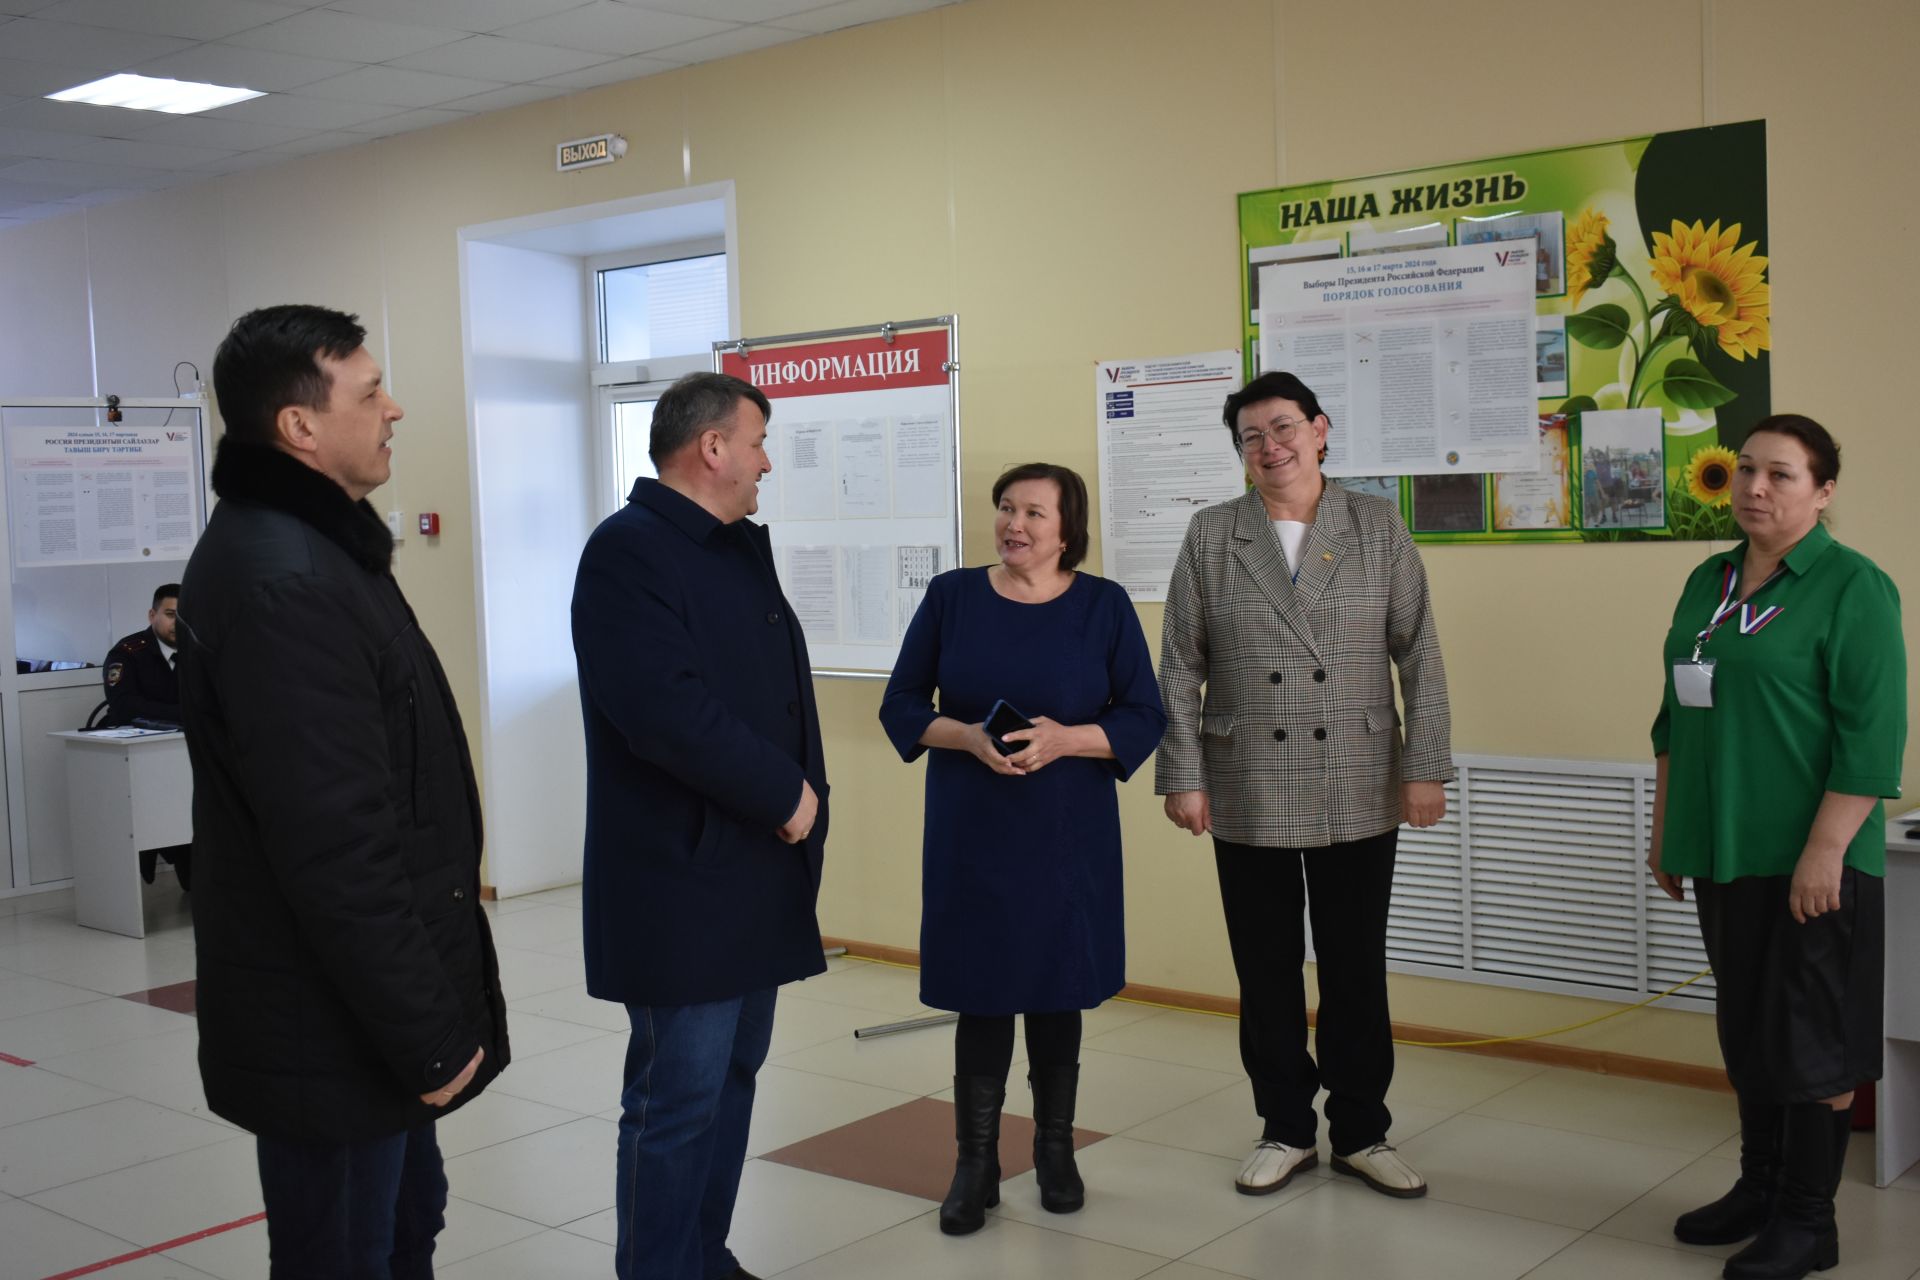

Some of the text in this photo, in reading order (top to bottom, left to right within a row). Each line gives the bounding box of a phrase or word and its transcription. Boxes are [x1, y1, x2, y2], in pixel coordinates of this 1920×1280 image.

[563, 141, 606, 163] ВЫХОД
[1280, 174, 1526, 230] НАША ЖИЗНЬ
[1303, 265, 1485, 290] Выборы Президента Российской Федерации
[1346, 266, 1356, 274] 15,
[1358, 265, 1366, 273] 16
[1373, 264, 1381, 272] 17
[1382, 262, 1403, 271] марта
[1404, 260, 1420, 269] 2024
[1421, 259, 1437, 268] года
[1322, 280, 1463, 302] ПОРЯДОК ГОЛОСОВАНИЯ
[749, 348, 921, 387] ИНФОРМАЦИЯ
